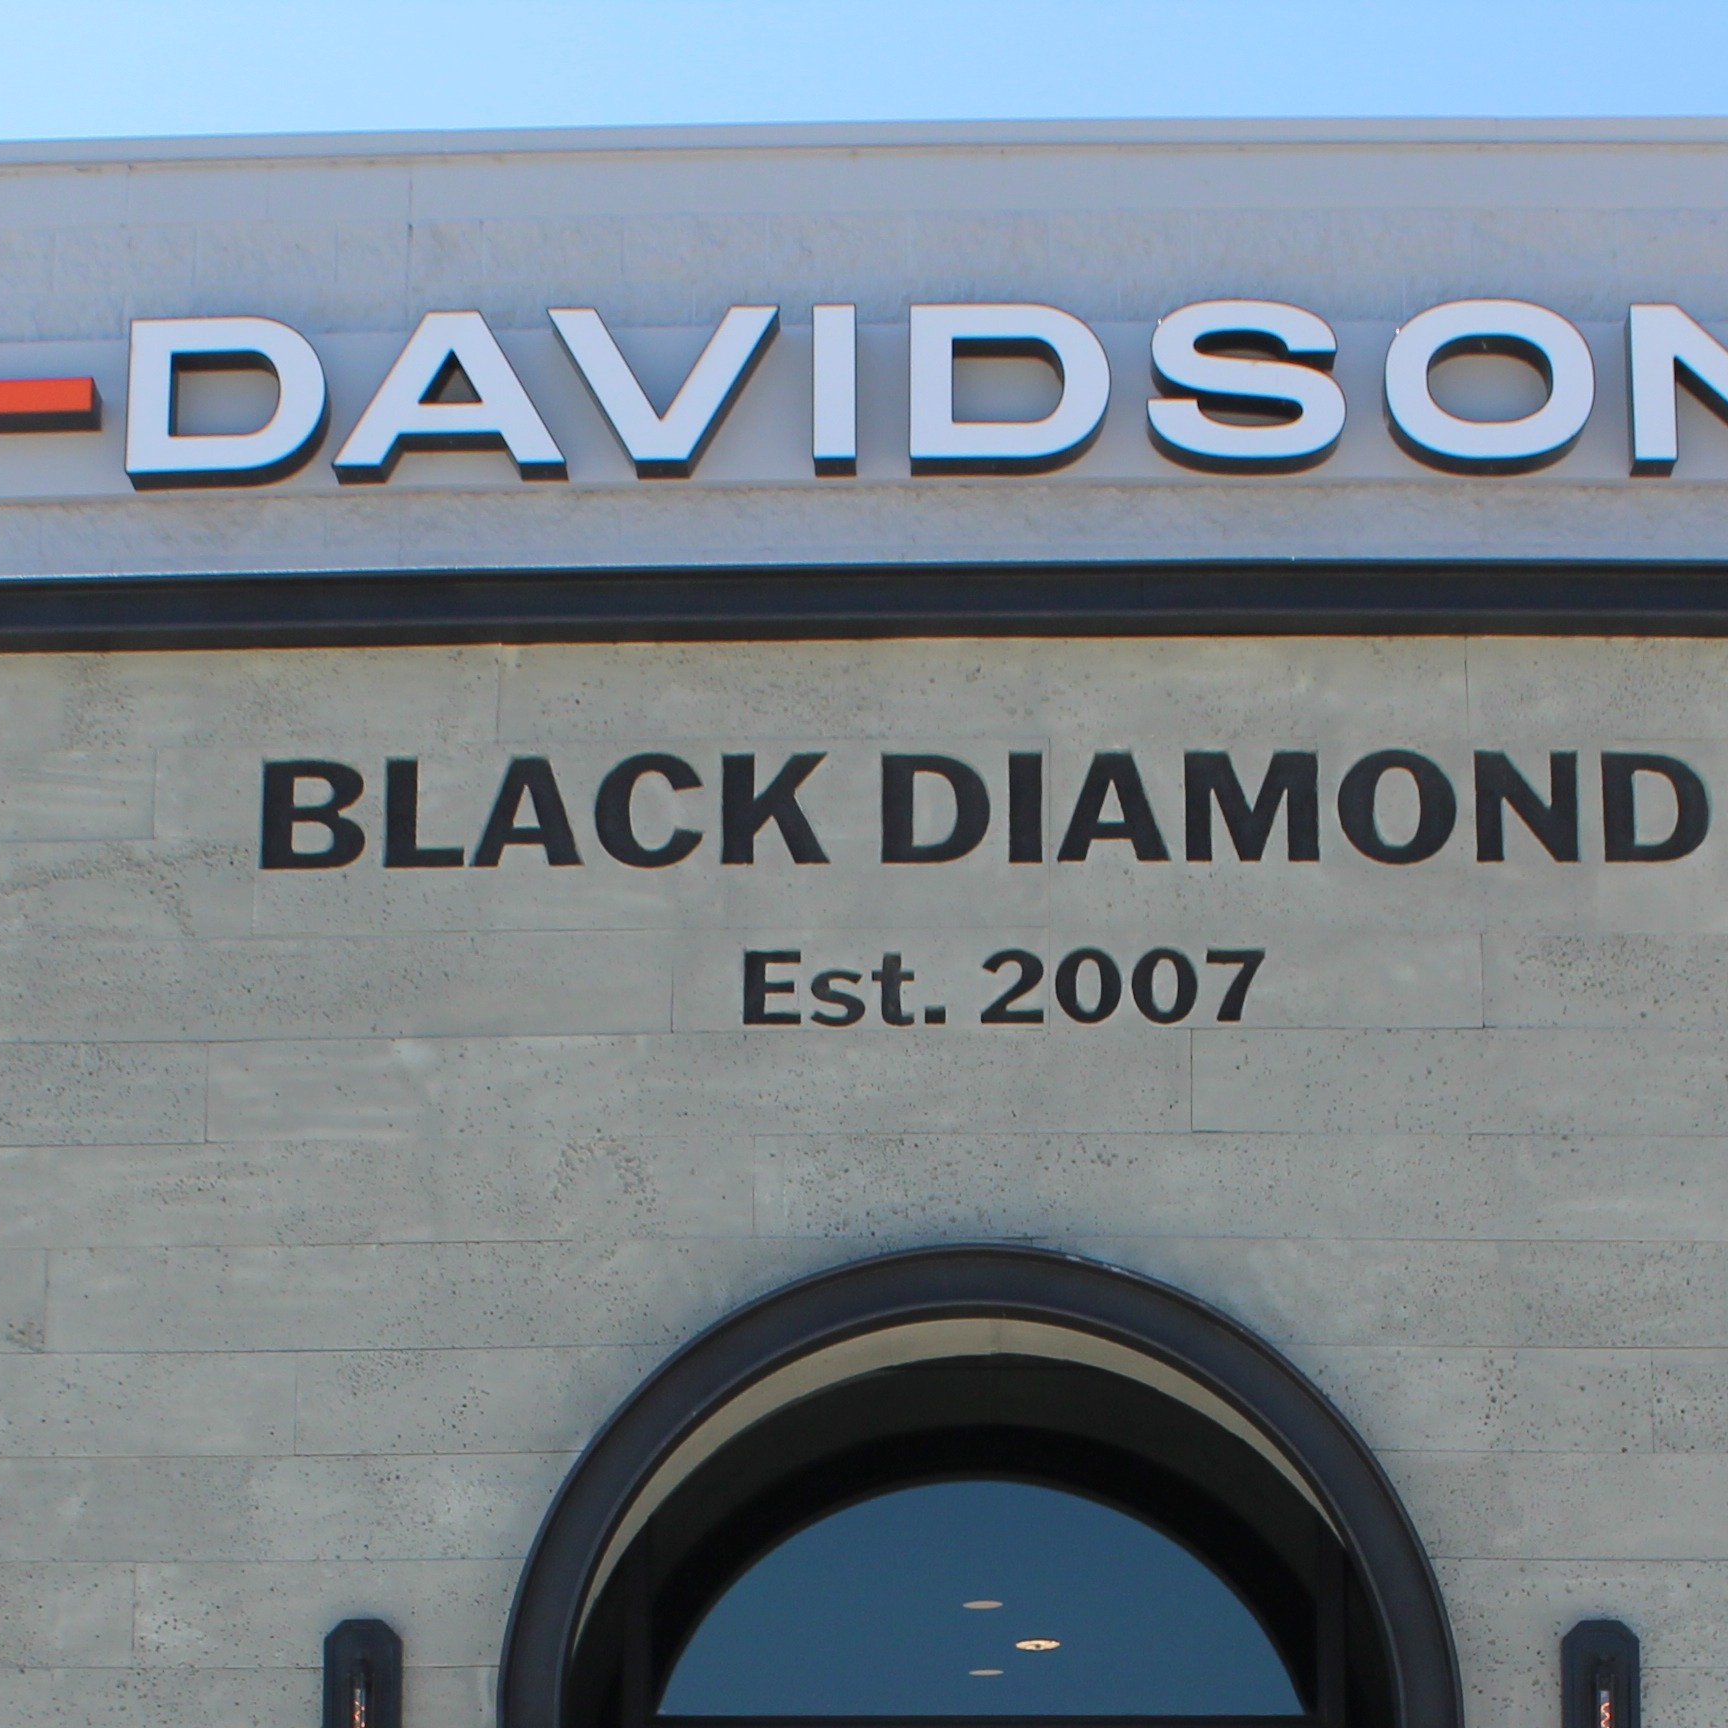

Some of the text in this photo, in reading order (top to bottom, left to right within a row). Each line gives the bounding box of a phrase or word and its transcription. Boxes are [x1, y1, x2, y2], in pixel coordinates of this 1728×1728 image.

[260, 750, 1713, 870] BLACK DIAMOND
[742, 947, 1267, 1027] Est. 2007
